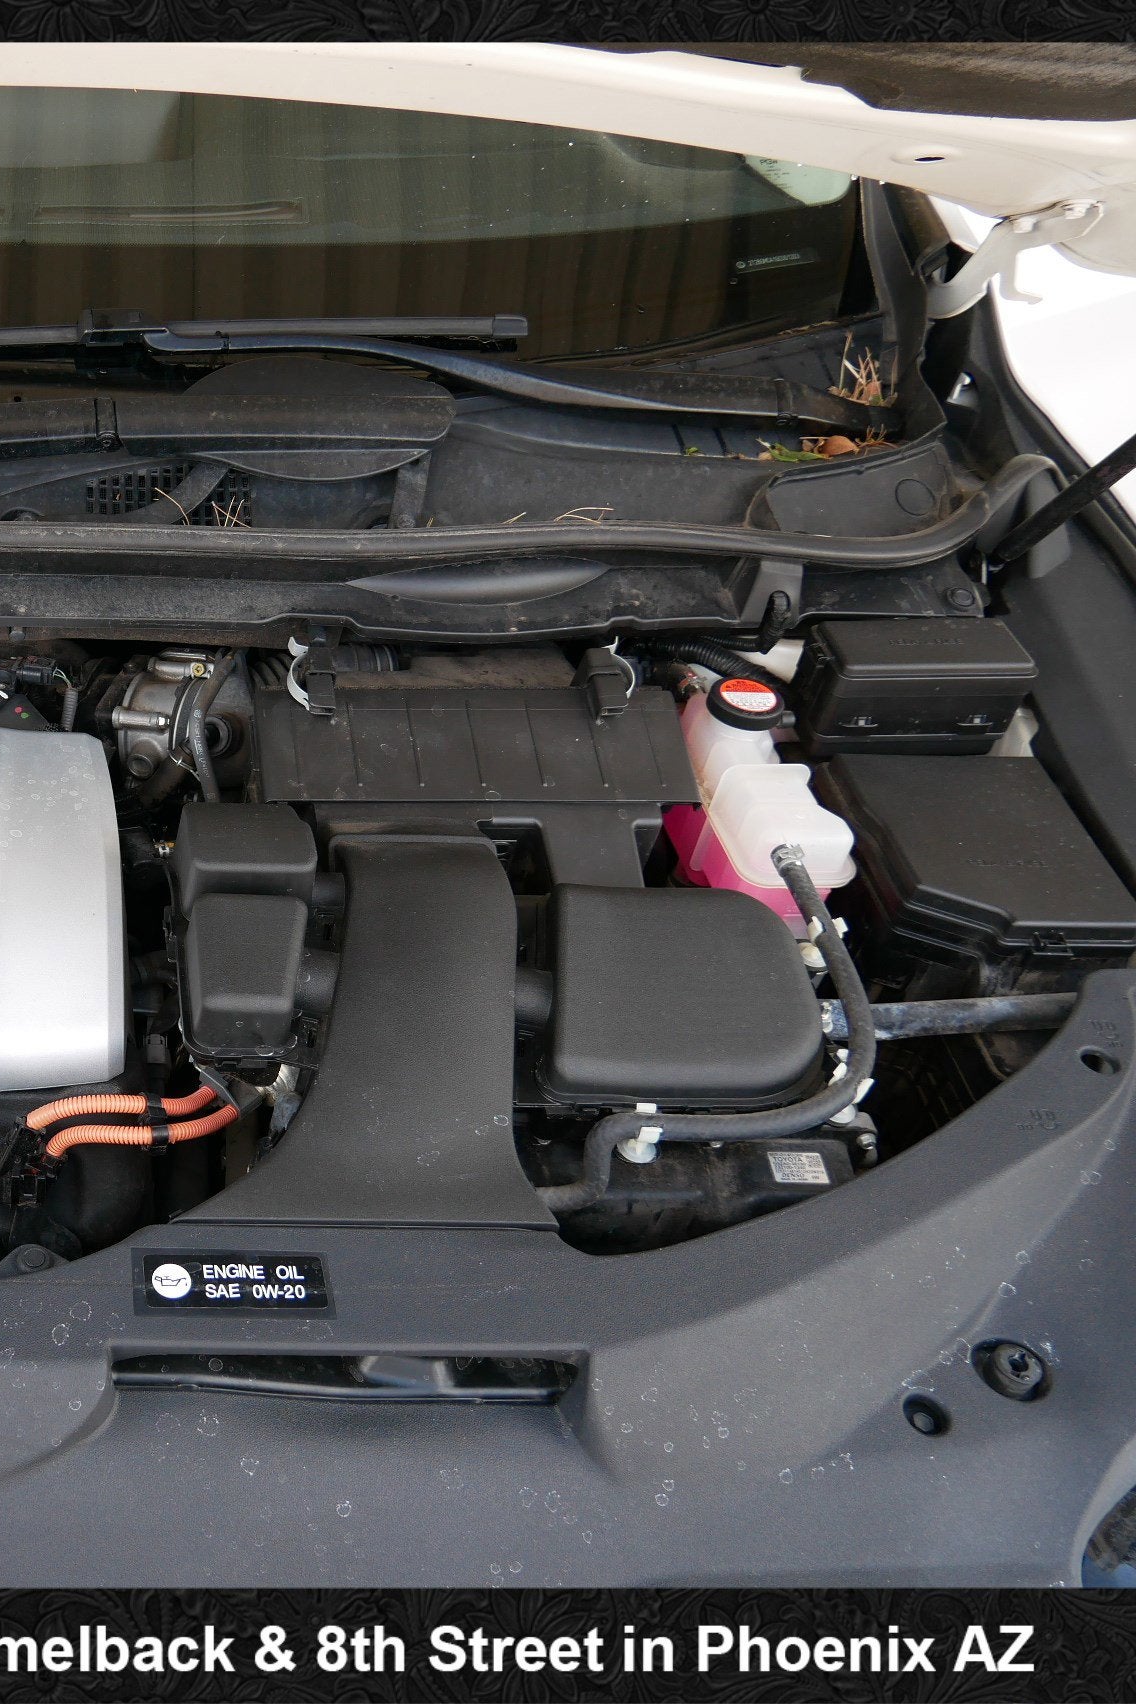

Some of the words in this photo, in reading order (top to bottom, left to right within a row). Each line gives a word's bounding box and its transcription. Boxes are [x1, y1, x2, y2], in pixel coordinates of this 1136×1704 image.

[202, 1263, 265, 1280] ENGINE
[275, 1264, 305, 1280] OIL
[204, 1283, 241, 1299] SAE
[252, 1284, 306, 1299] 0W-20
